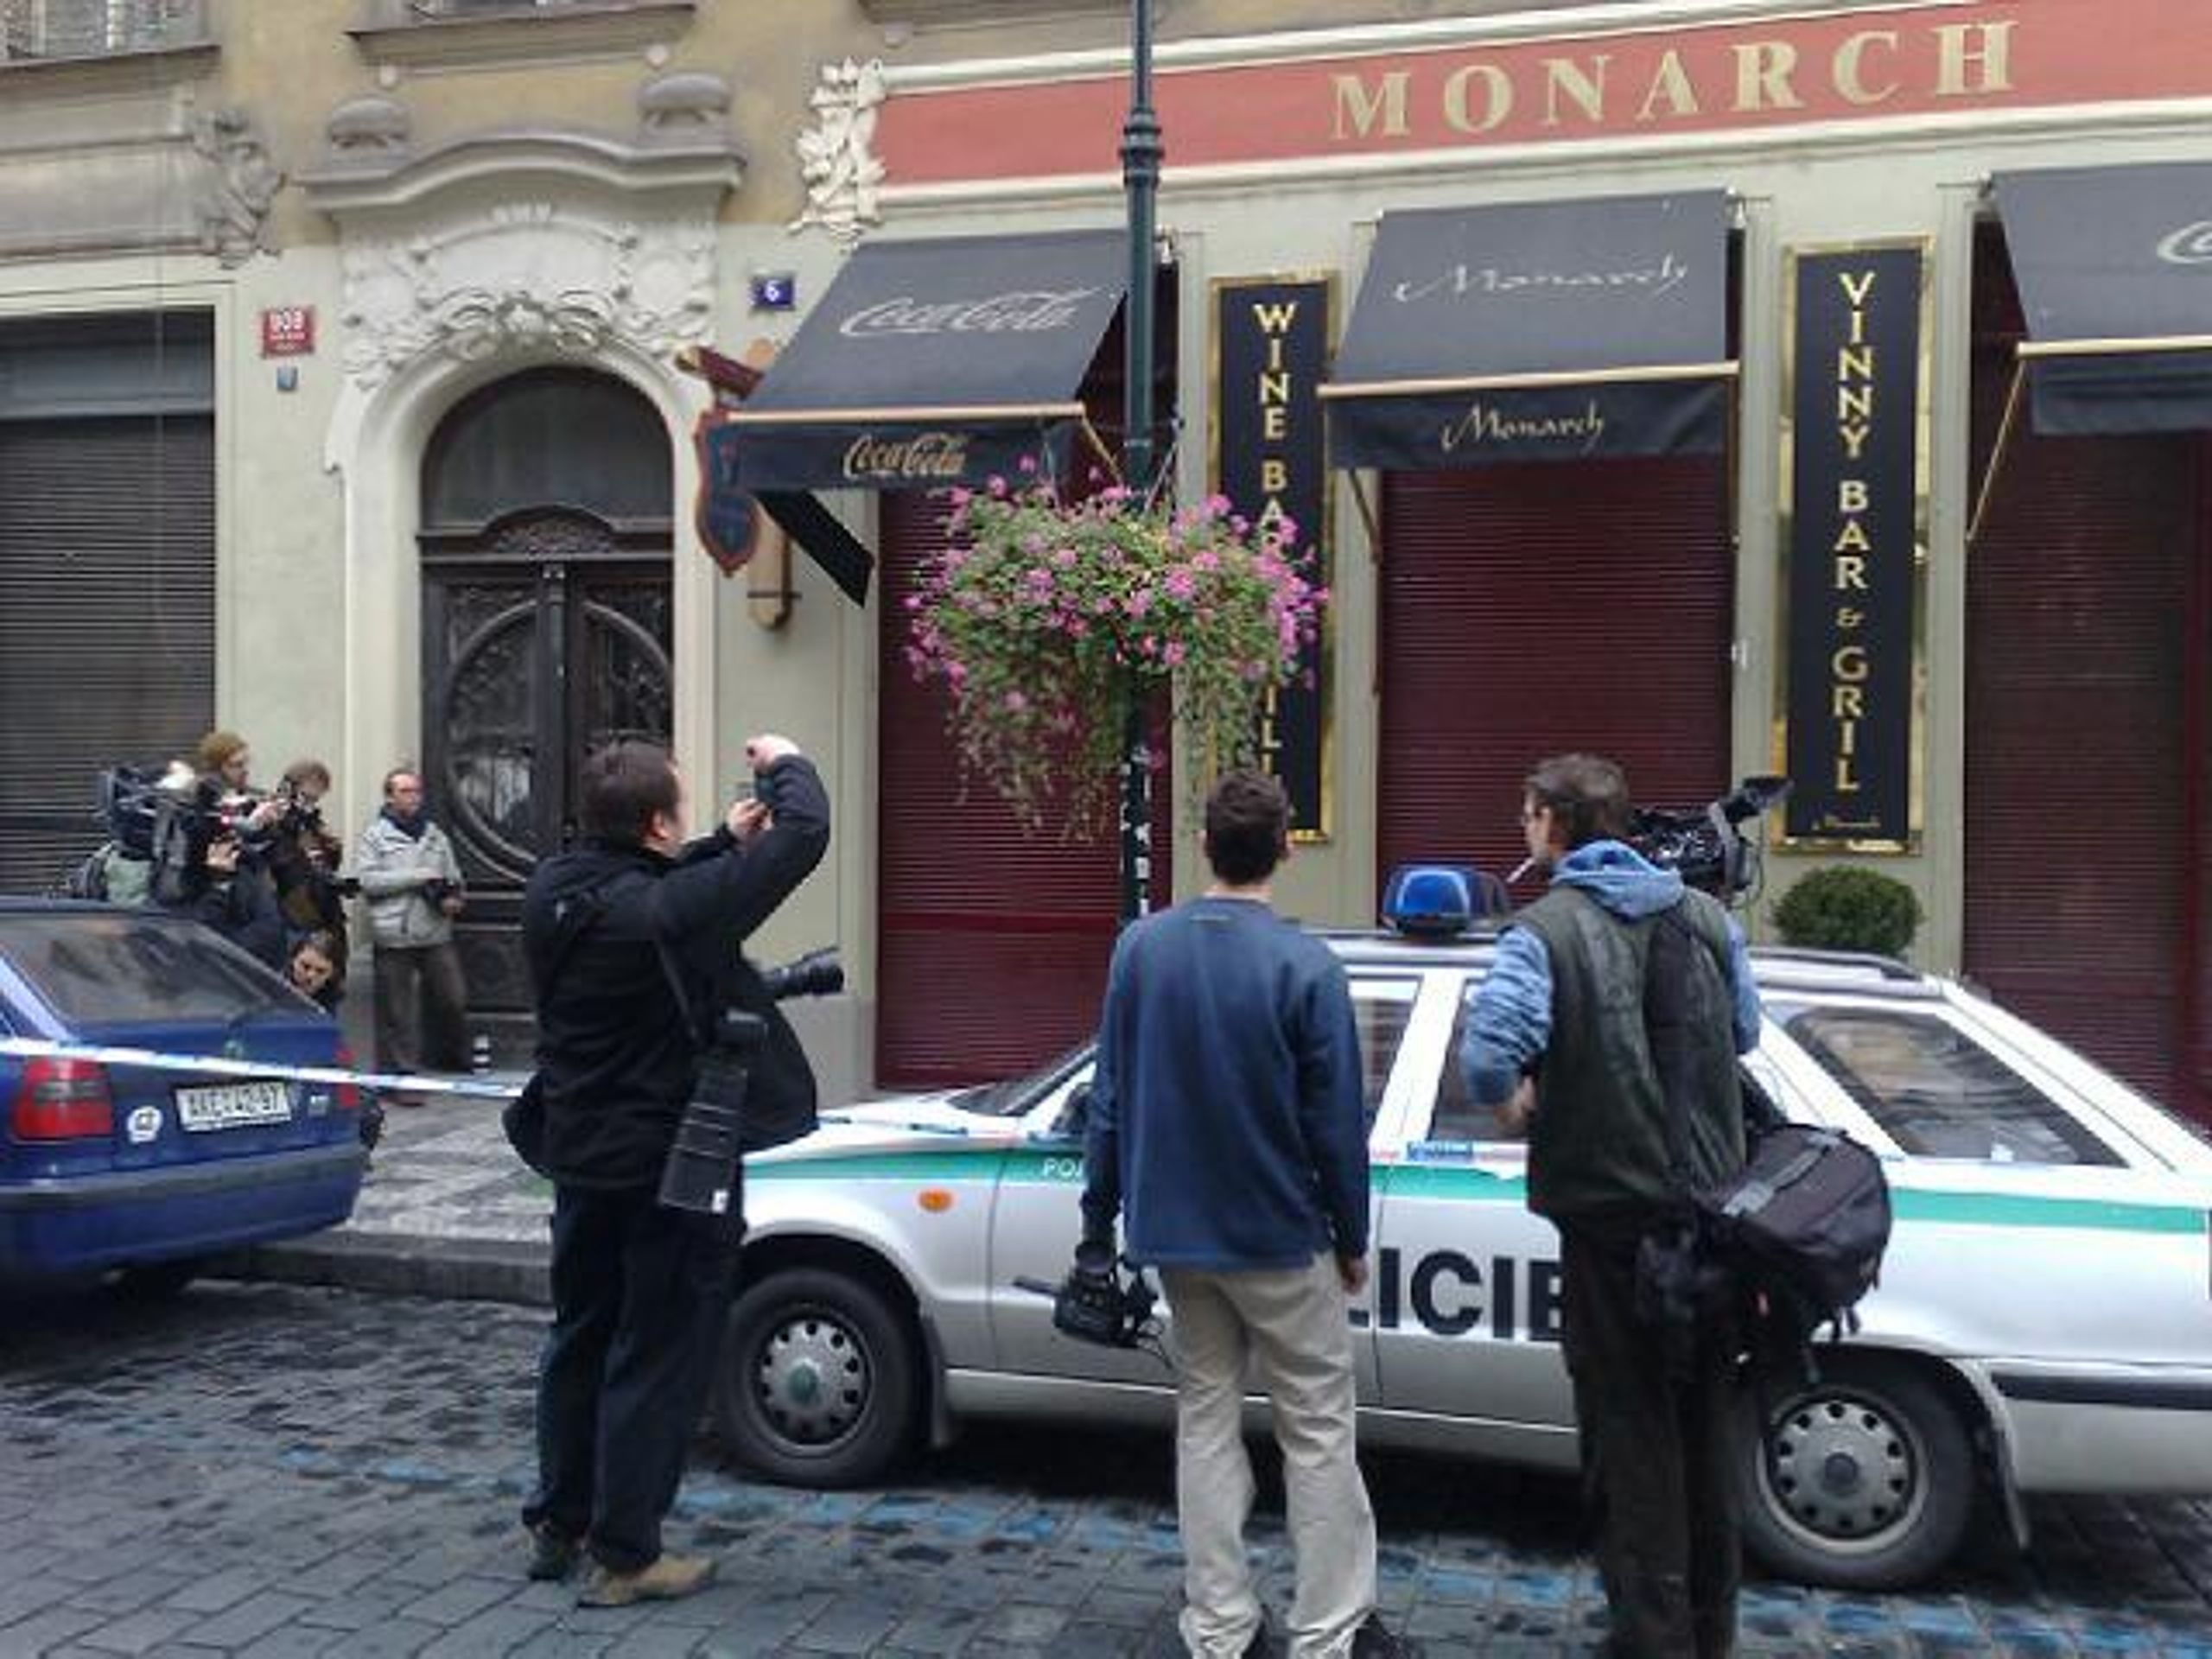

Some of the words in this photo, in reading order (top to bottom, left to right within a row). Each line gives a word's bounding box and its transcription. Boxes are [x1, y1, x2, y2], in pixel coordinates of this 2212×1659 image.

[1332, 20, 2018, 141] MONARCH
[1394, 252, 1689, 306] Monarch
[1254, 303, 1297, 440] WINE
[1837, 271, 1877, 460] VINNY
[1441, 401, 1605, 453] Monarch
[1834, 480, 1870, 589] BAR
